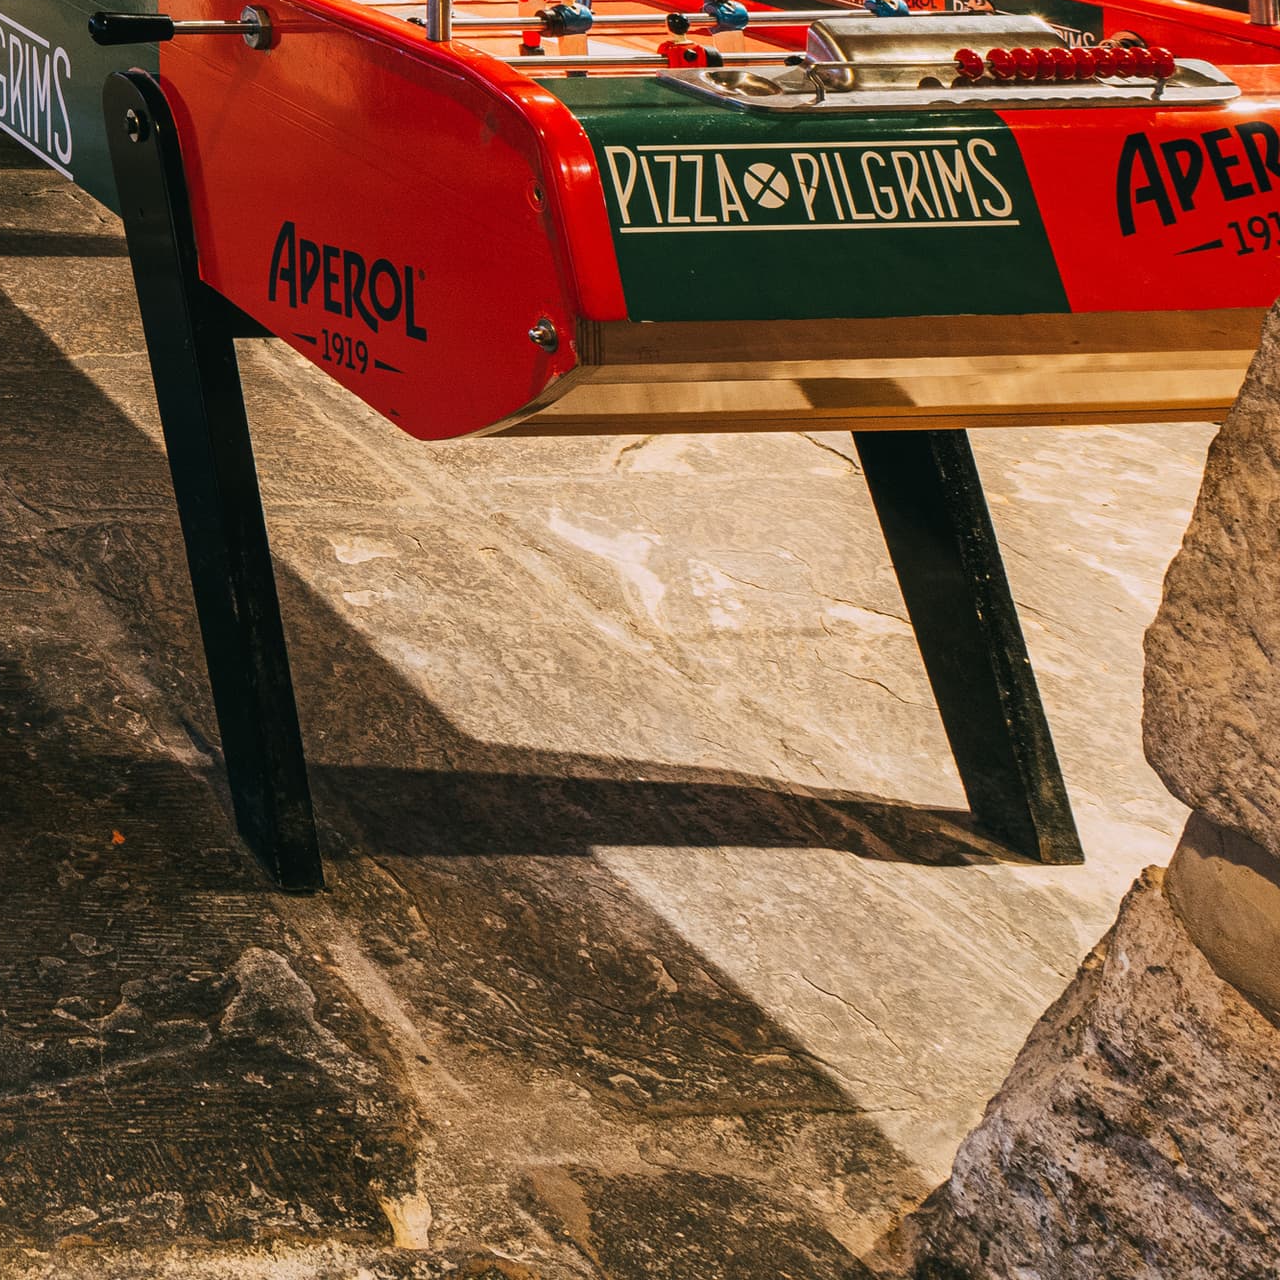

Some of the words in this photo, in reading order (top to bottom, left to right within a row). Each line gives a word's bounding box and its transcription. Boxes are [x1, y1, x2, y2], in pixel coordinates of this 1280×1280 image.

[604, 145, 750, 224] PIZZA
[791, 138, 1014, 221] PILGRIMS
[268, 220, 428, 343] APEROL
[321, 328, 369, 375] 1919
